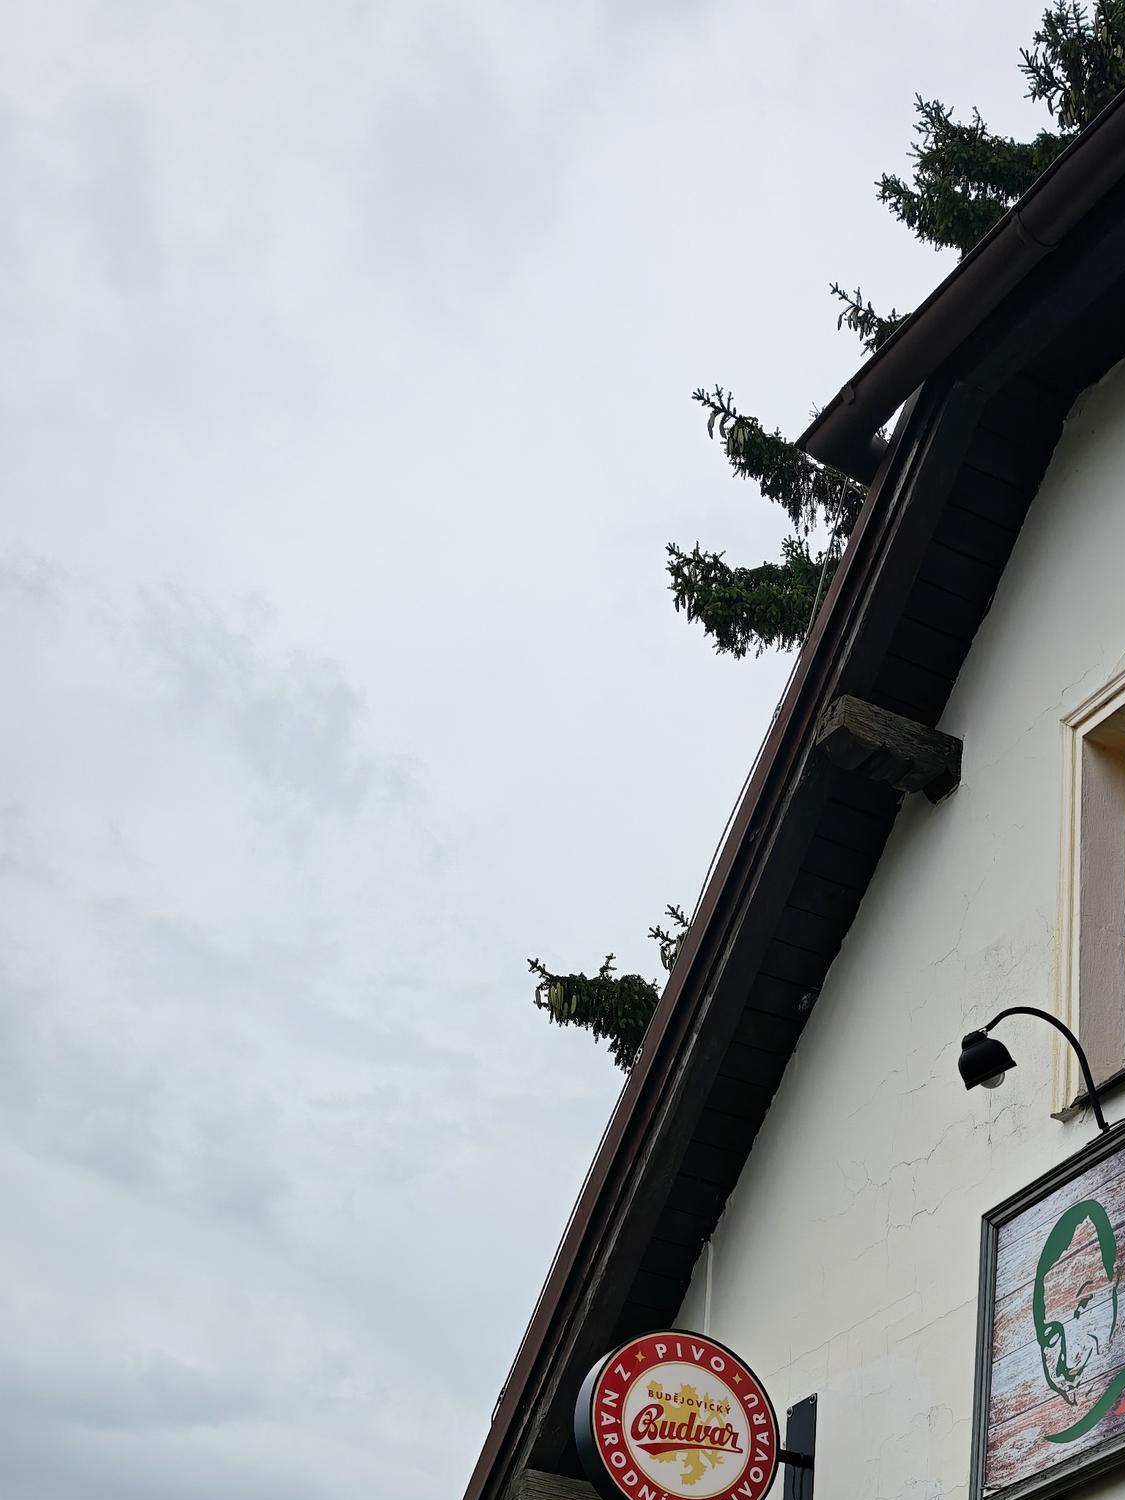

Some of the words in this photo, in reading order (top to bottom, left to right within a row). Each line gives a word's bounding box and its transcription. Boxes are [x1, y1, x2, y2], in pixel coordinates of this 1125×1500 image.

[655, 1343, 726, 1372] PIVO
[614, 1363, 631, 1382] Z
[648, 1390, 731, 1415] BUDĚJOVICKÝ
[631, 1404, 743, 1453] Budvar
